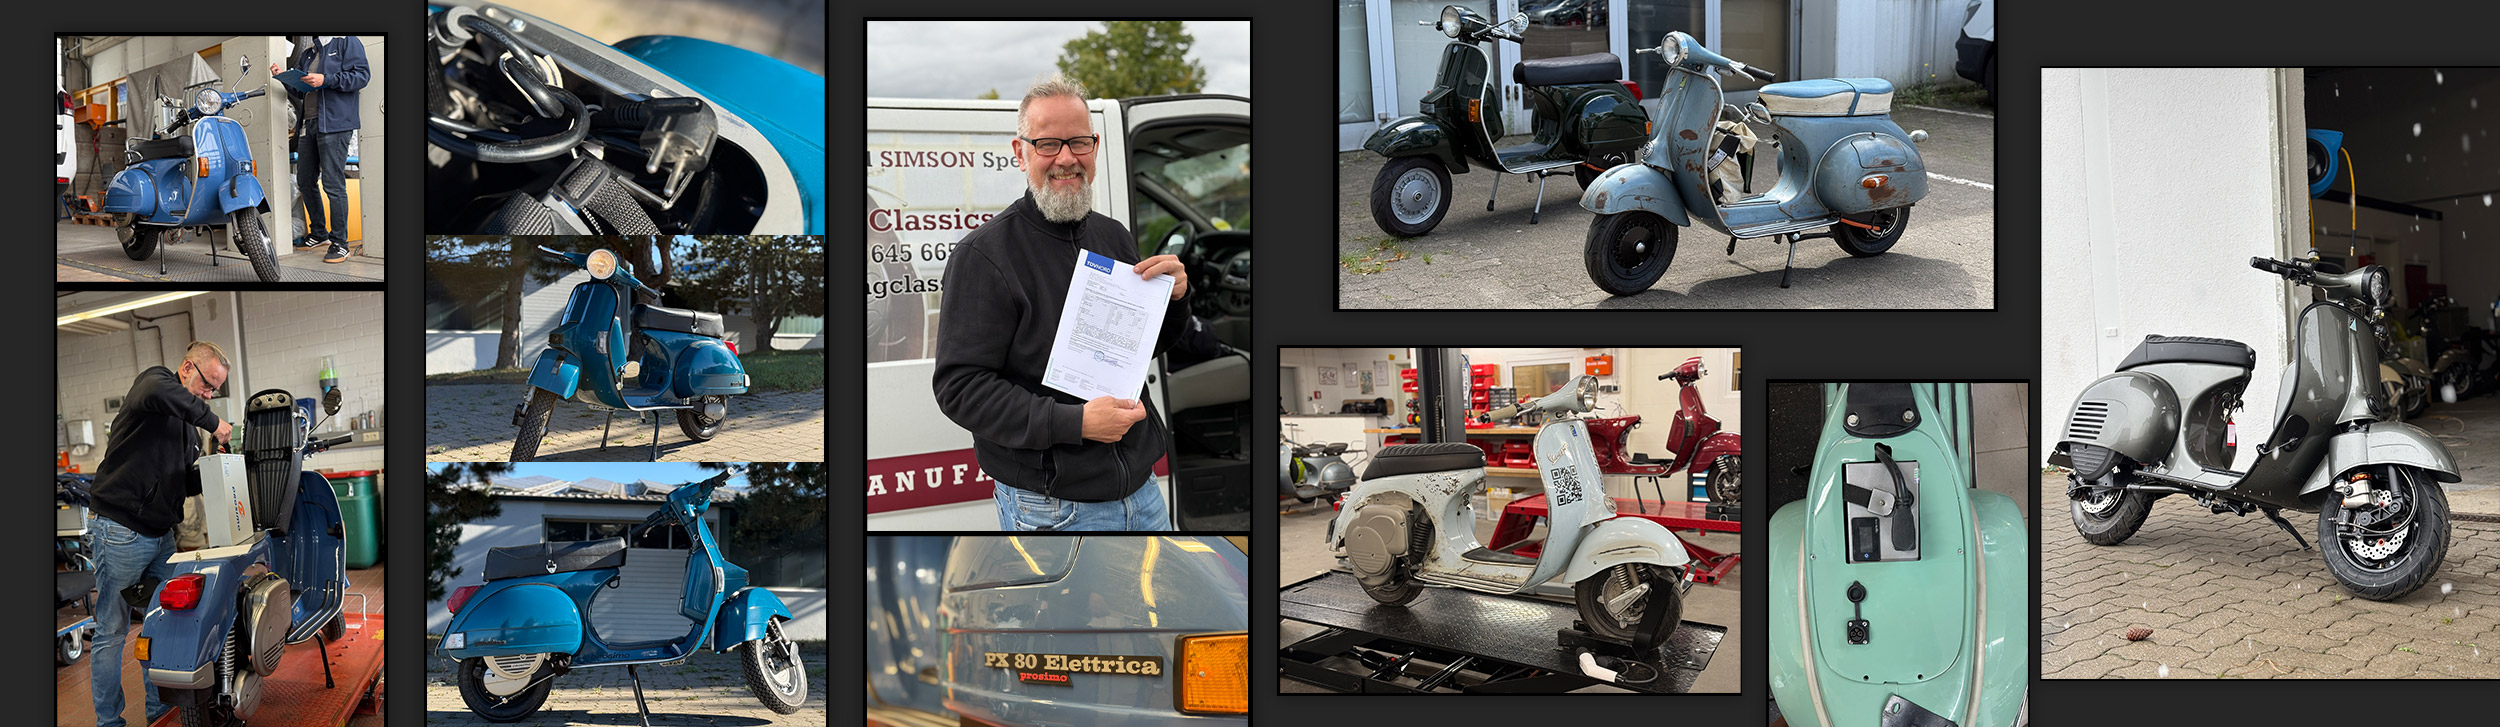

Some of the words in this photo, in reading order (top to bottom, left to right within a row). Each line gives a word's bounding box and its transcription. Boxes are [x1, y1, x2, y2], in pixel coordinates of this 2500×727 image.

[880, 151, 975, 168] SIMSON
[871, 244, 912, 263] 645
[867, 275, 943, 299] gclas
[984, 652, 1009, 667] PX
[1014, 653, 1037, 669] 80
[1043, 654, 1161, 675] Elettrica
[1019, 672, 1068, 682] prosimo
